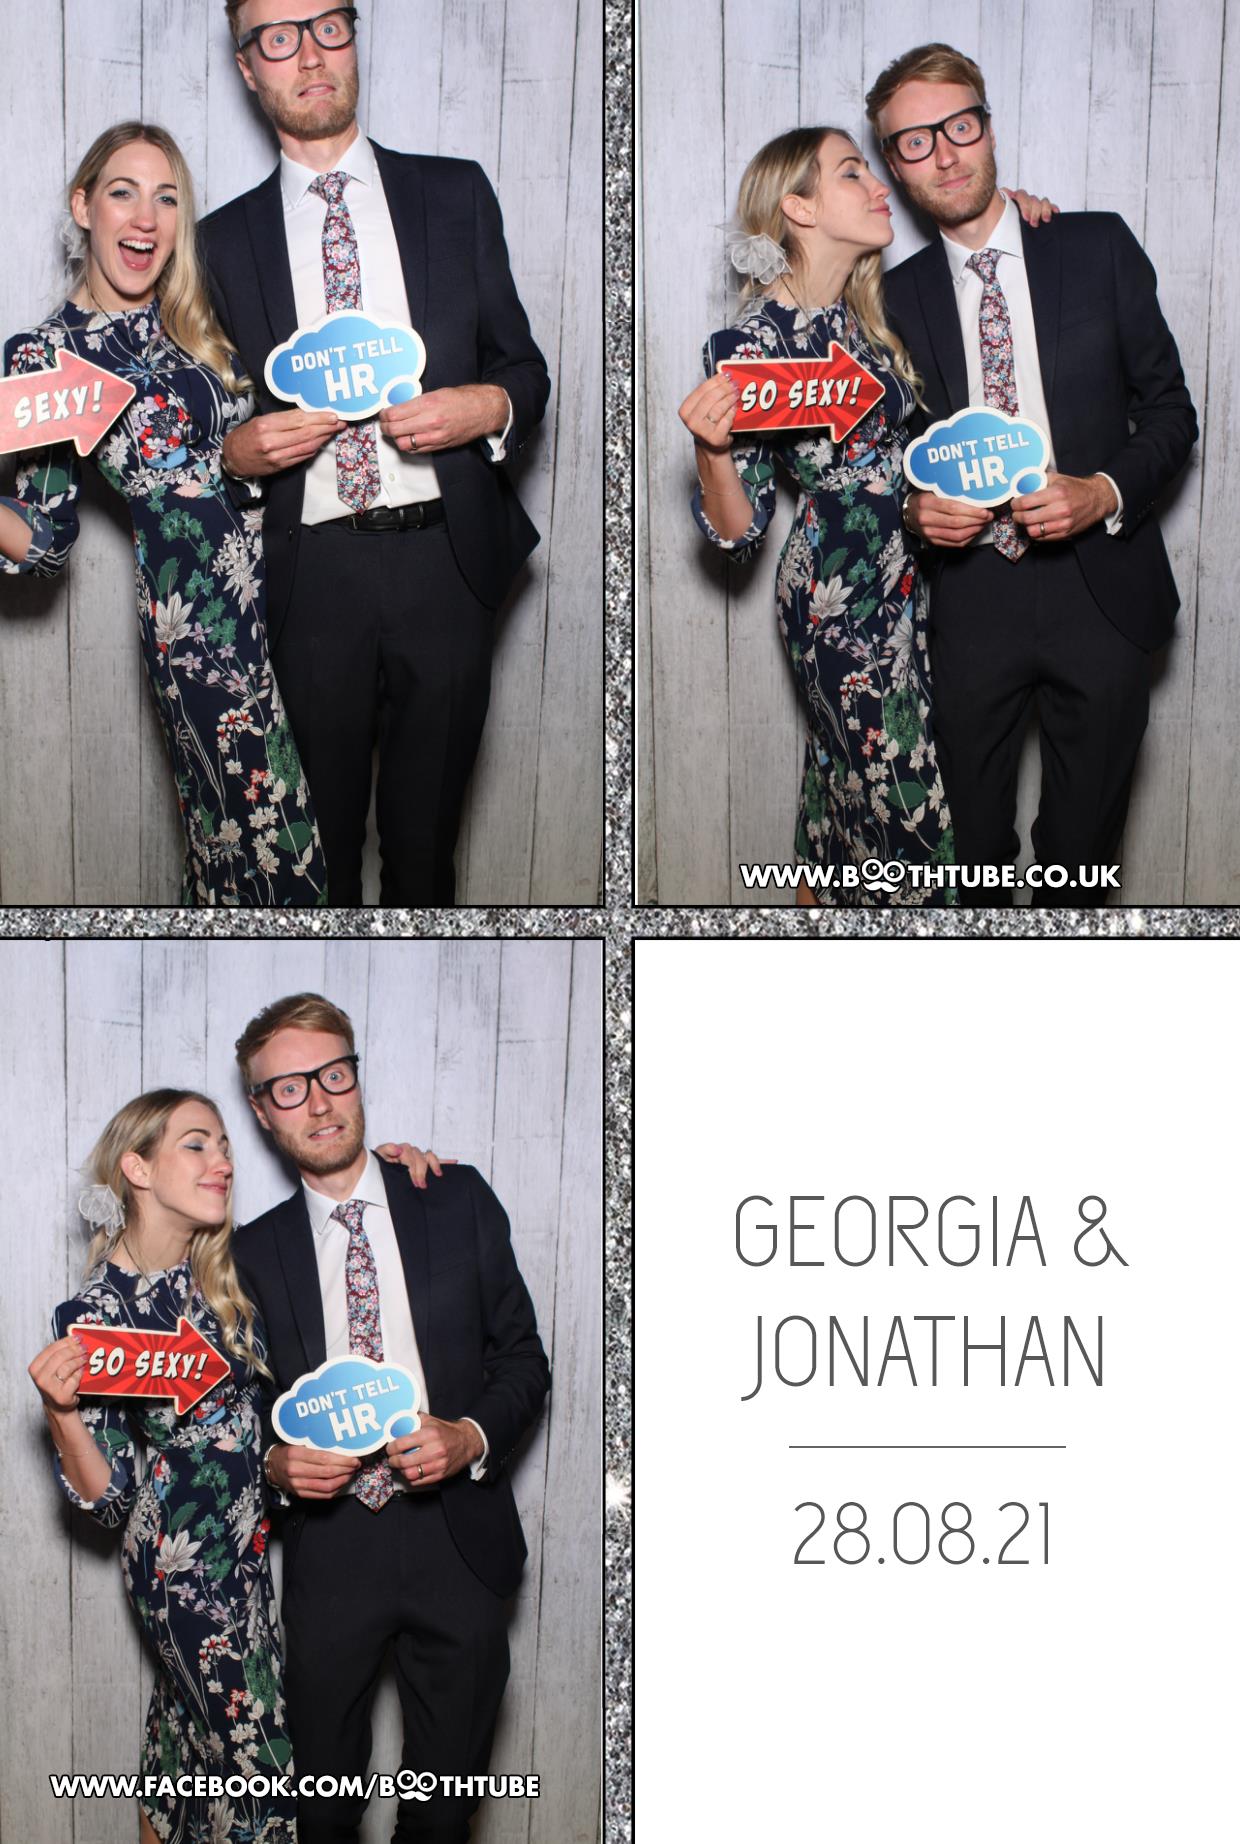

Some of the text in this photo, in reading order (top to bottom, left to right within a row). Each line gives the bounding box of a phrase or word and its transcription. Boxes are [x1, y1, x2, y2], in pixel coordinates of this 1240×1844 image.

[291, 335, 404, 373] DON'T TELL
[324, 364, 380, 402] HR
[740, 376, 862, 412] SO SEXY!
[13, 380, 103, 429] SEXY!
[926, 430, 1030, 464] DON'T TELL
[957, 455, 1009, 491] HR
[88, 1346, 209, 1381] SO SEXY!
[295, 1375, 400, 1418] DON'T TELL
[328, 1402, 382, 1442] HR
